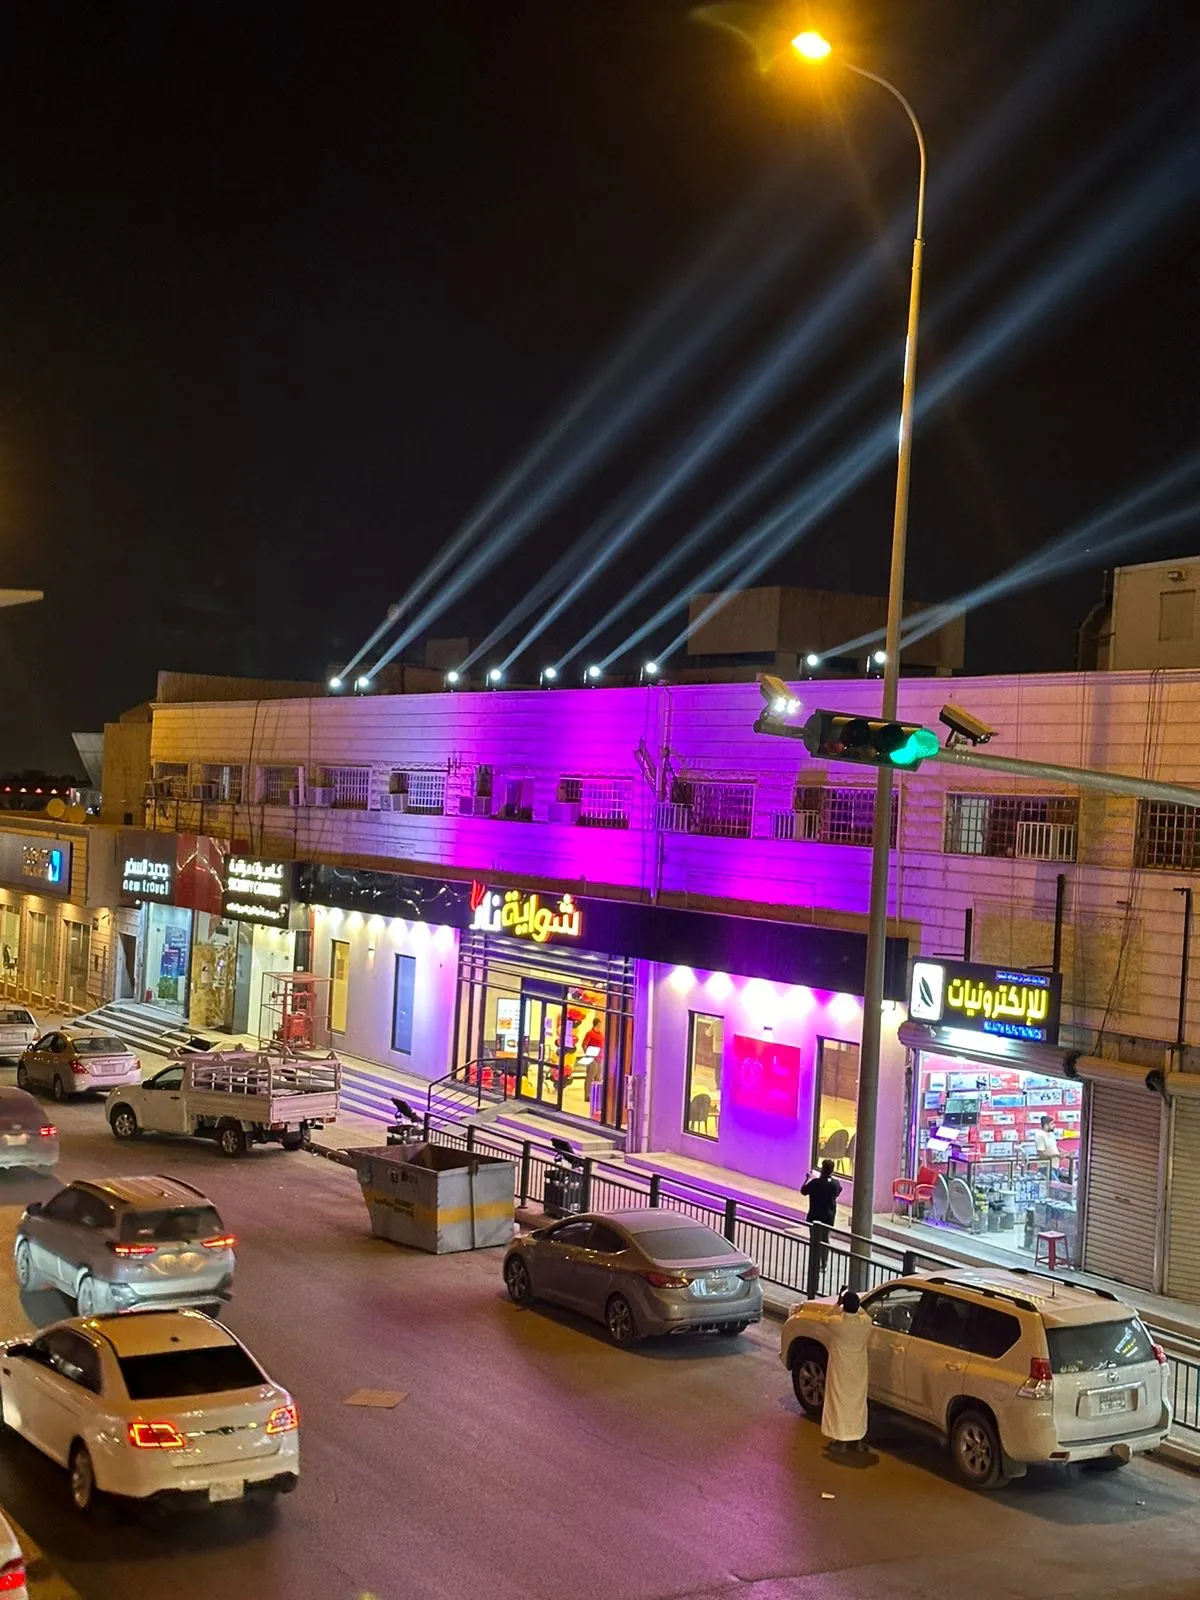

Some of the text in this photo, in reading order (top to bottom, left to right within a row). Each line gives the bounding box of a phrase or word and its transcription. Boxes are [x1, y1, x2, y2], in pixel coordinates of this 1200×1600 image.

[122, 879, 169, 895] new travel
[123, 857, 169, 881] جديد السفر
[469, 890, 582, 943] شواية نار
[947, 978, 1049, 1026] للإلكترونيات
